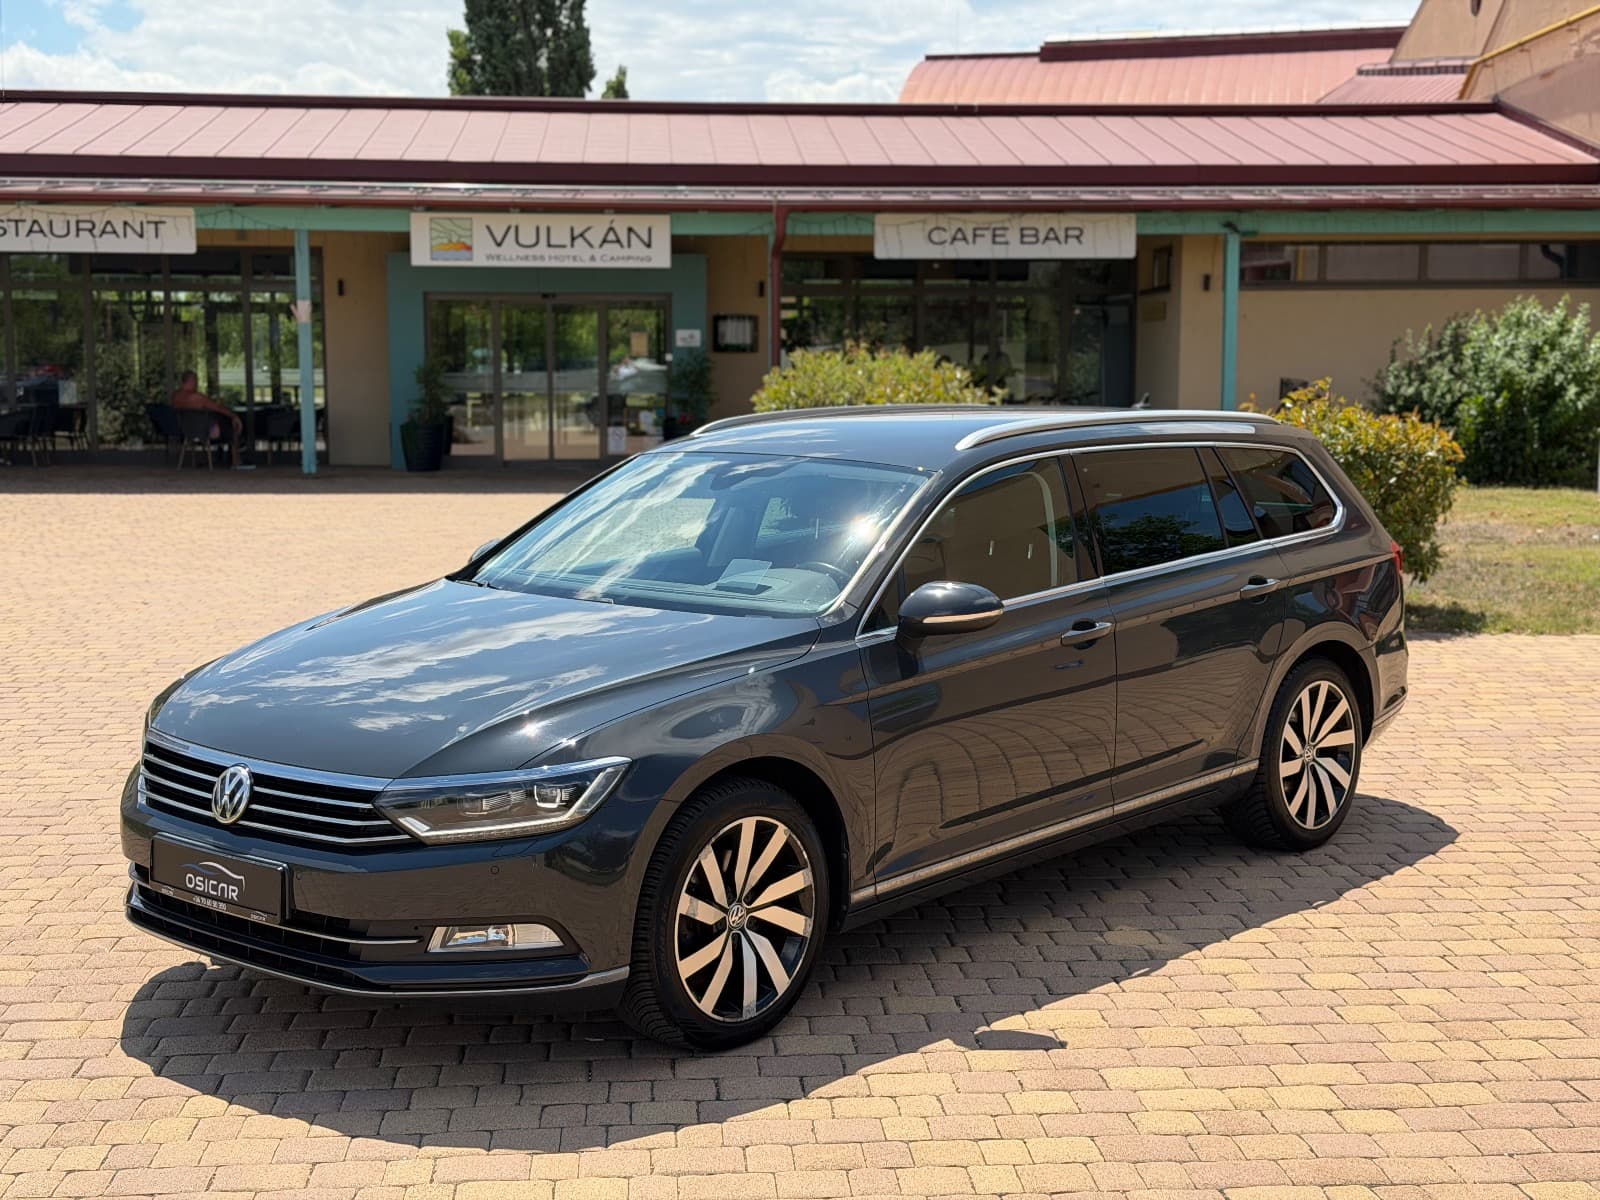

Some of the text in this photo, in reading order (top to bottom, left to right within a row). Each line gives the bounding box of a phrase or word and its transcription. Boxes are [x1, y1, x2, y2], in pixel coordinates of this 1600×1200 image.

[485, 218, 653, 249] VULKÁN
[927, 226, 1085, 246] CAFE BAR
[548, 253, 586, 263] HOTEL
[185, 873, 239, 901] OSICAR
